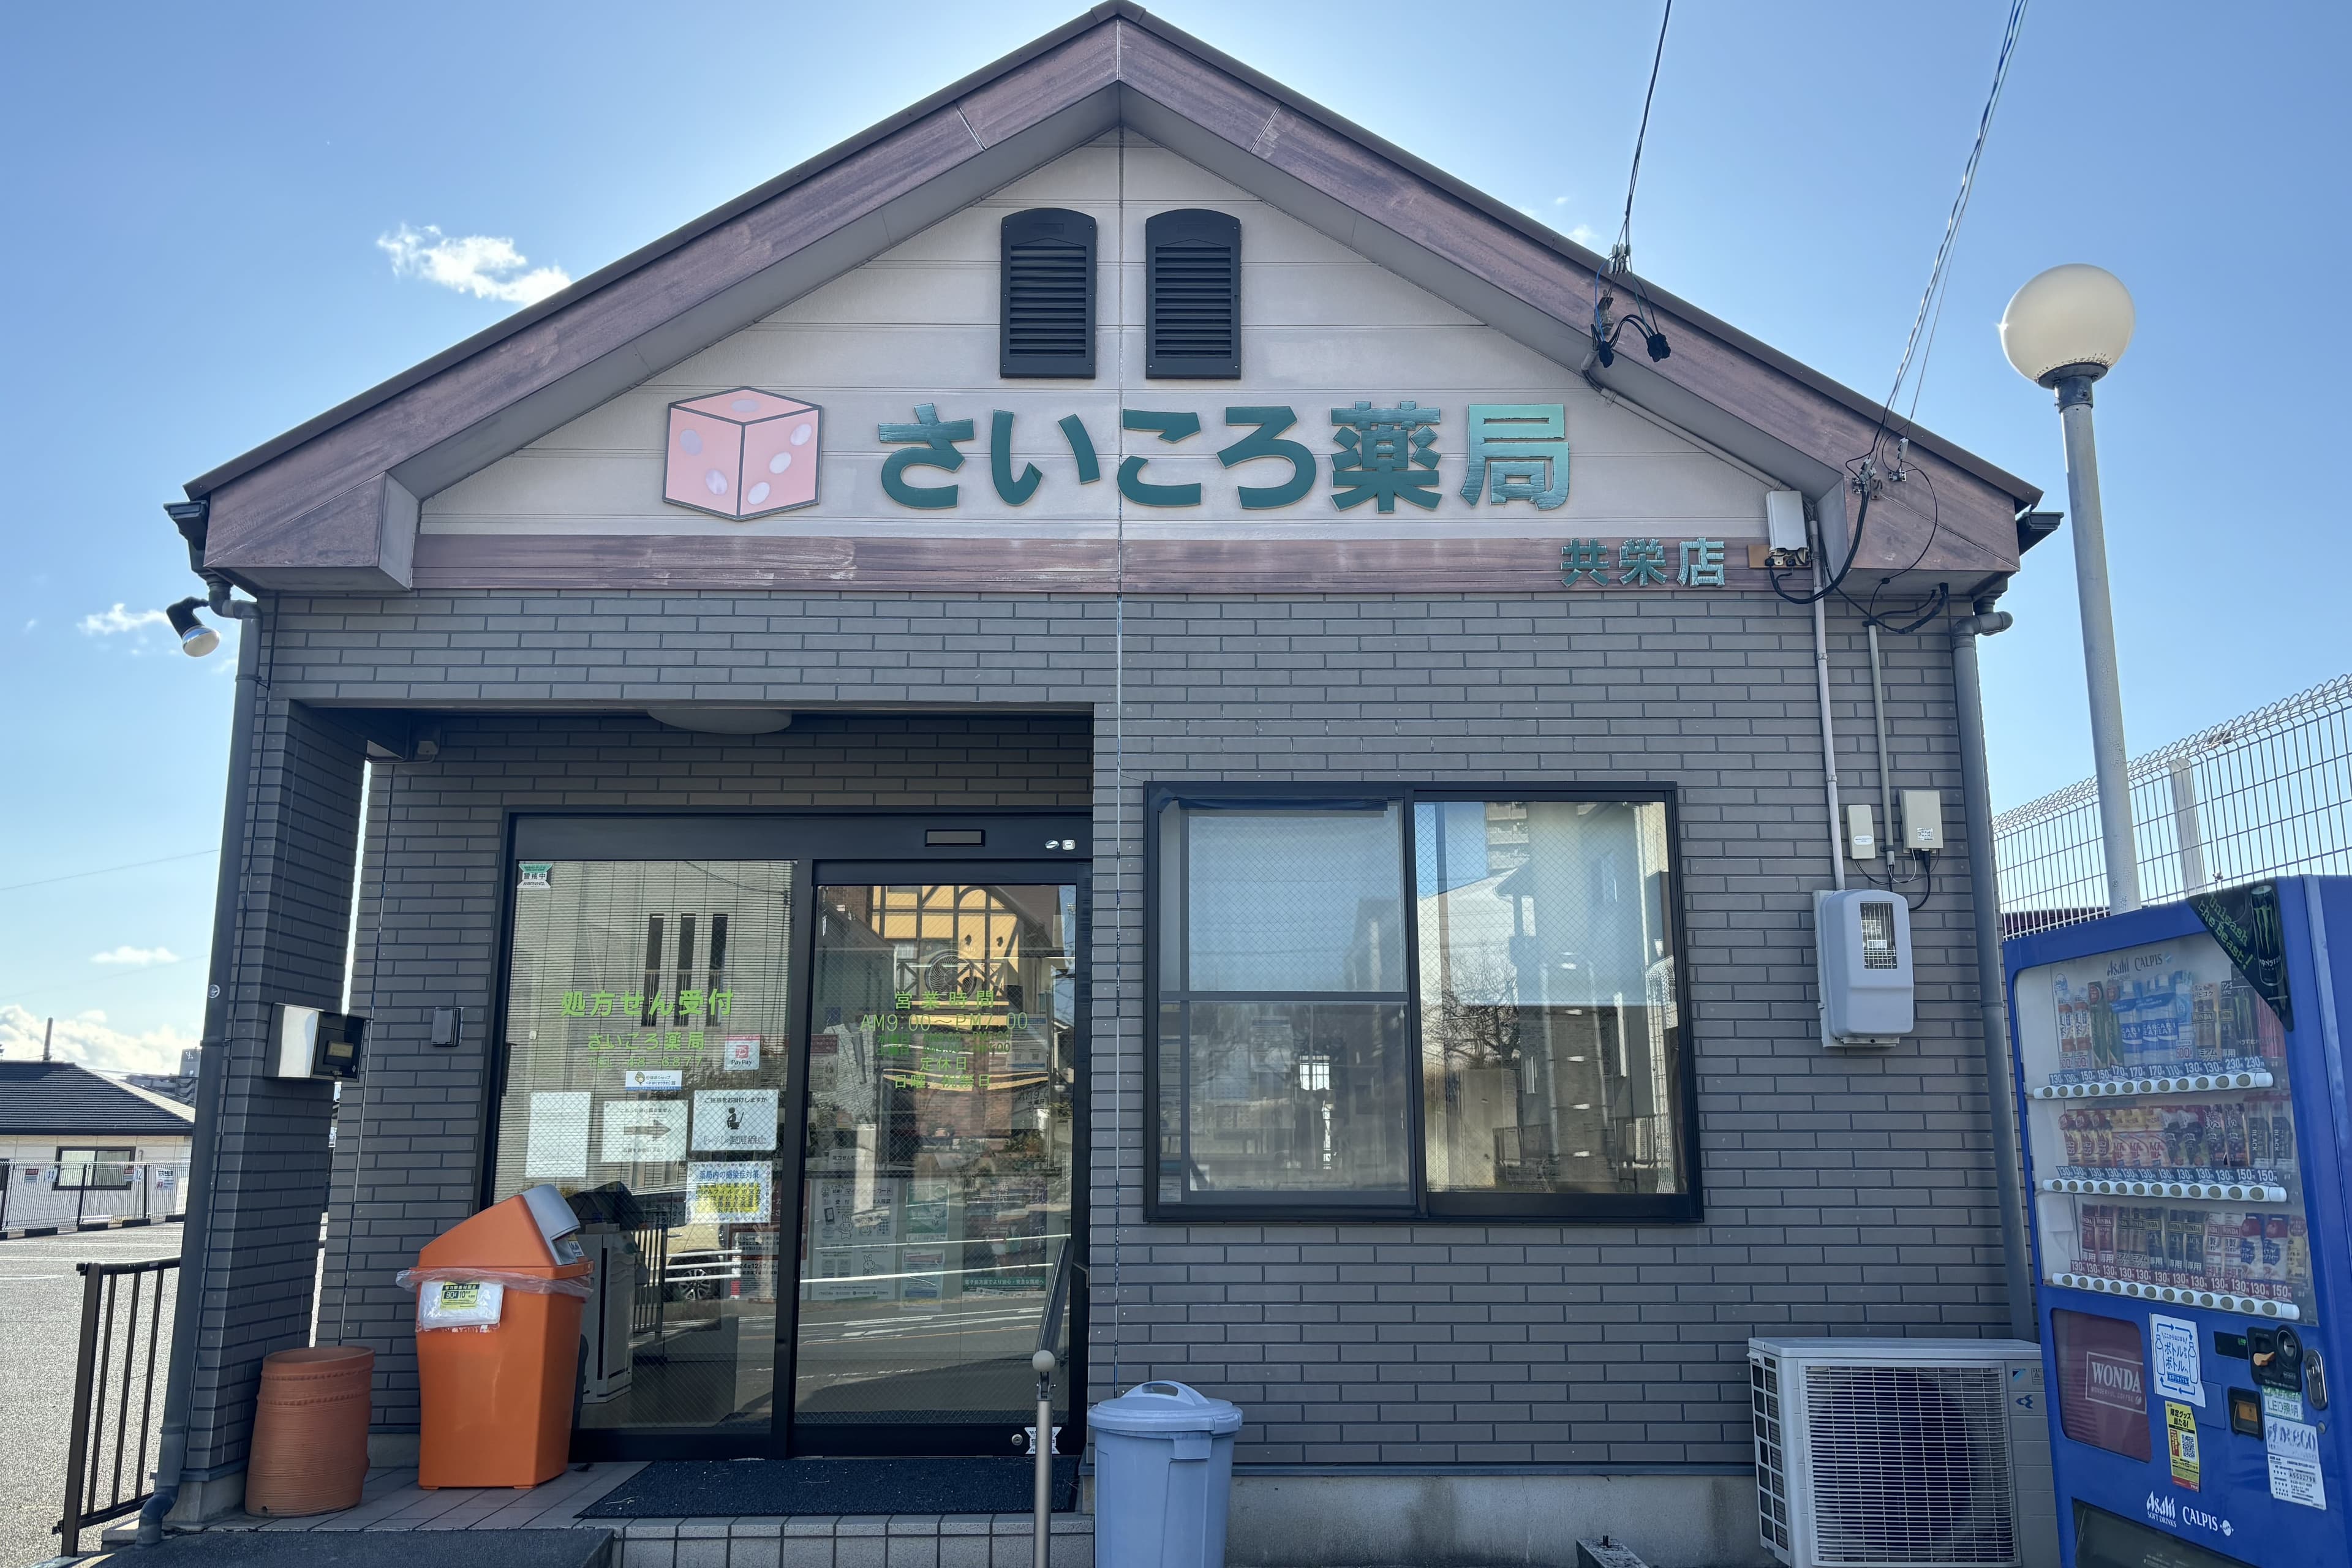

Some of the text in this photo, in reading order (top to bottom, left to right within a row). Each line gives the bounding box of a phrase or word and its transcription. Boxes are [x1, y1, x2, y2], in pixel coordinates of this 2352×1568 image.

[878, 402, 1569, 512] さいころ薬局
[1560, 537, 1725, 588] 共栄店
[2198, 900, 2254, 970] the Beast!
[2209, 894, 2248, 947] Unleash
[2107, 954, 2162, 976] Asahi CALPIS
[560, 988, 734, 1017] 処方せん受付
[895, 990, 994, 1010] 営業時間
[588, 1031, 704, 1050] さいころ薬局
[588, 1057, 612, 1068] TEL
[920, 1057, 967, 1071] 定休日
[2092, 1362, 2142, 1393] WONDA
[2146, 1490, 2218, 1531] Asahi CALPIS
[2147, 1510, 2177, 1528] SOFT DRINKS
